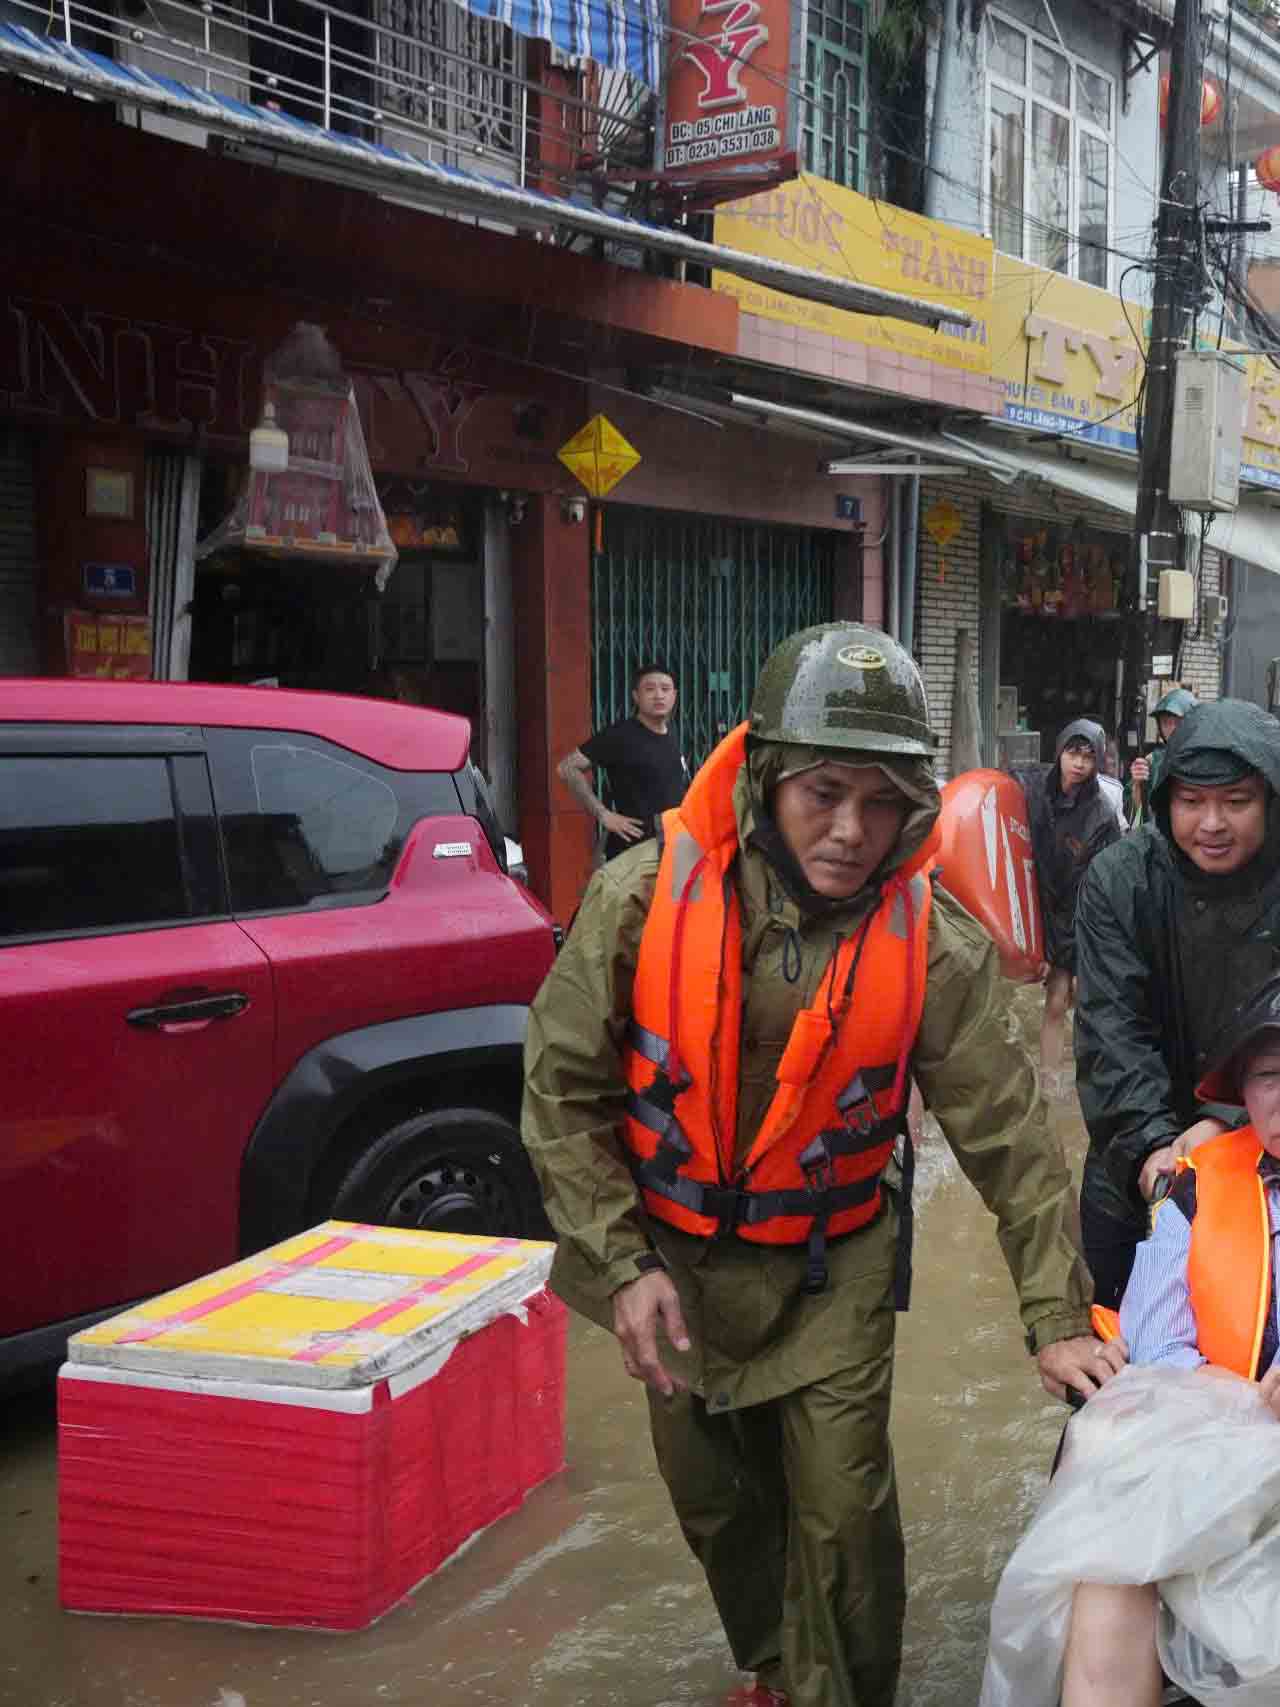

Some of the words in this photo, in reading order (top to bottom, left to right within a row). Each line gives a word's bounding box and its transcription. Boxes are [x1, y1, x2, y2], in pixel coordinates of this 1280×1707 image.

[696, 119, 711, 135] 05
[714, 114, 735, 132] CHI
[688, 142, 717, 160] 0234
[721, 135, 748, 154] 3531
[752, 129, 774, 147] 038
